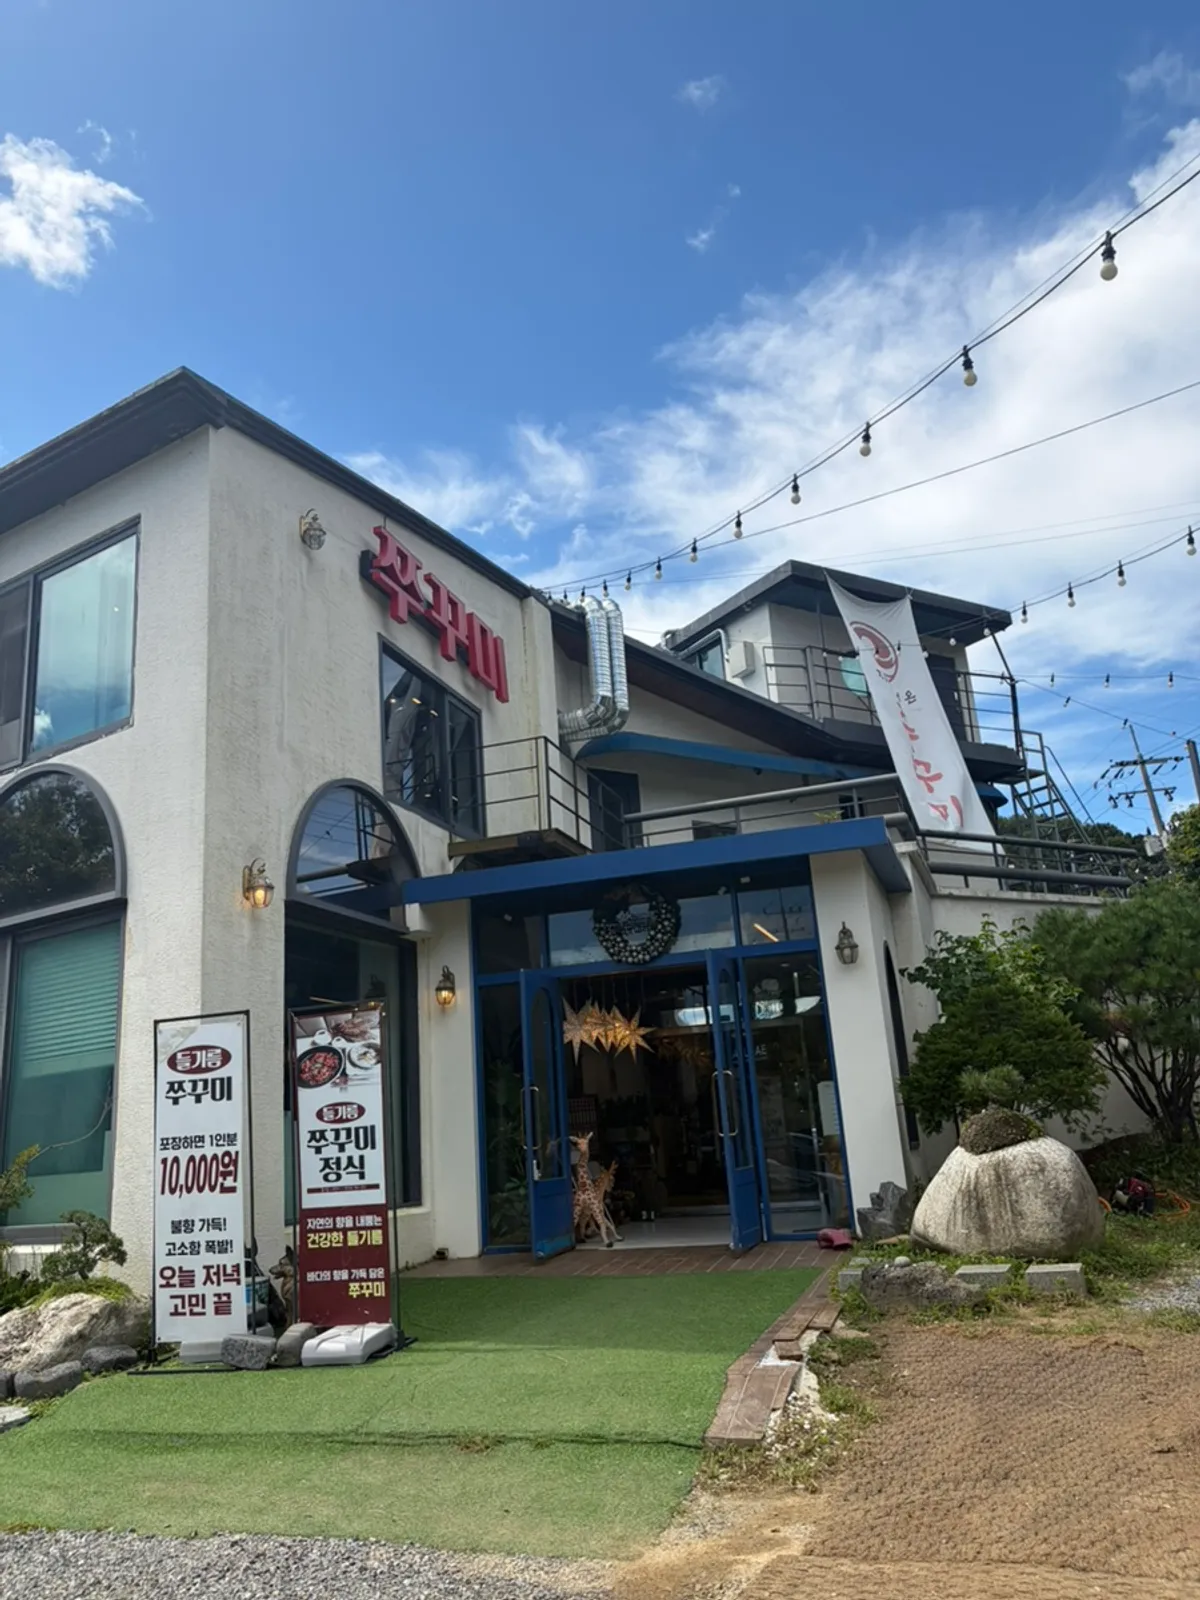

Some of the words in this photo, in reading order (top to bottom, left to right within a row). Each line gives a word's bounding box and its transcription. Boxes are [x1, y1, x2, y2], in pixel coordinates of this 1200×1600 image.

[370, 525, 510, 704] 쭈꾸미
[175, 1048, 223, 1071] 들기름
[164, 1076, 232, 1106] 쭈꾸미
[322, 1104, 359, 1121] 들기름
[159, 1134, 205, 1151] 포장하면
[209, 1132, 238, 1147] 1인분
[306, 1124, 377, 1155] 쭈꾸미
[160, 1150, 240, 1199] 10,000원
[318, 1154, 366, 1183] 정식
[171, 1218, 195, 1235] 불향
[198, 1217, 227, 1233] 가득!
[306, 1216, 334, 1230] 자연의
[165, 1239, 201, 1257] 고소함
[204, 1239, 234, 1255] 폭발!
[306, 1231, 344, 1249] 건강한
[347, 1229, 383, 1247] 들기름
[159, 1265, 196, 1288] 오늘
[202, 1262, 241, 1287] 저녁
[350, 1268, 368, 1280] 가득
[348, 1281, 386, 1299] 쭈꾸미
[169, 1293, 207, 1317] 고민
[213, 1292, 232, 1316] 끝
